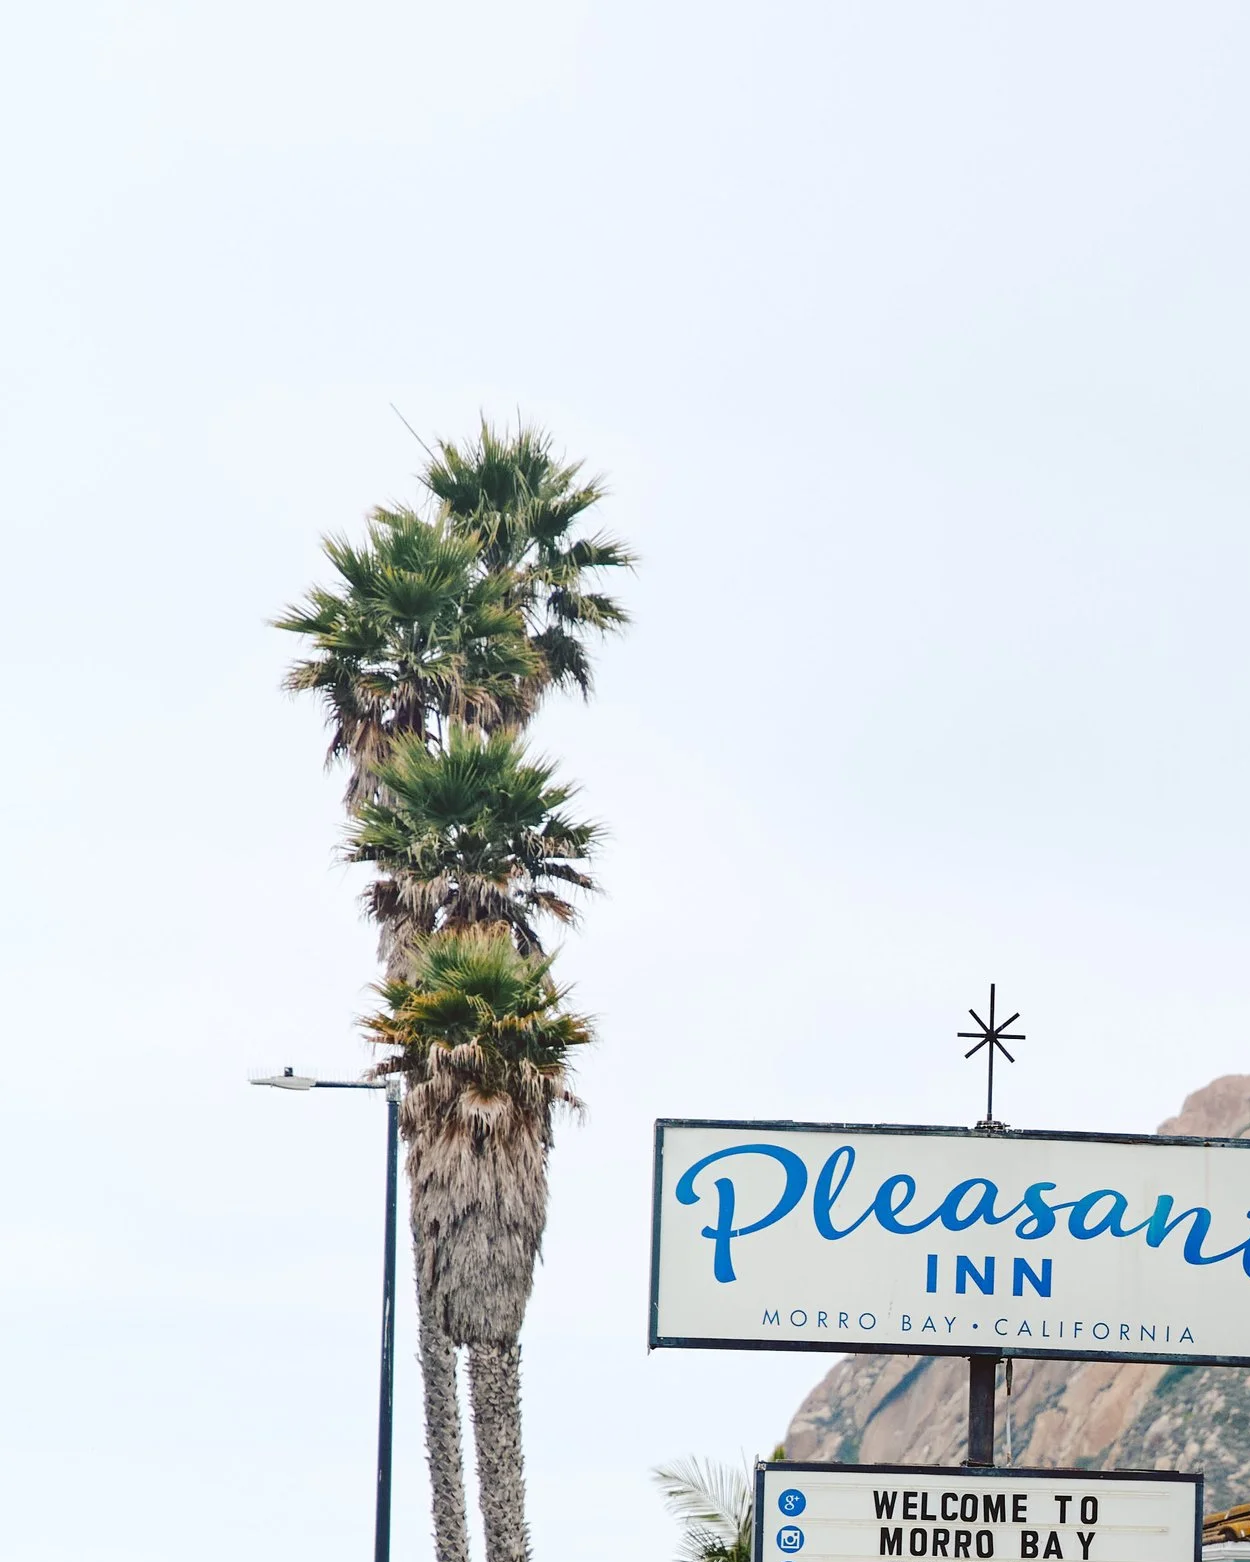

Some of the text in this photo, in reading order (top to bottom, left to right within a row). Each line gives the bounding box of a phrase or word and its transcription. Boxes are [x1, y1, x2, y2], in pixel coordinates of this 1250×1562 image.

[925, 1254, 1052, 1298] INN
[762, 1308, 1196, 1344] MORRO BAY CALIFORNIA
[873, 1490, 1099, 1525] WELCOME TO
[879, 1527, 1096, 1561] MORRO BAY
